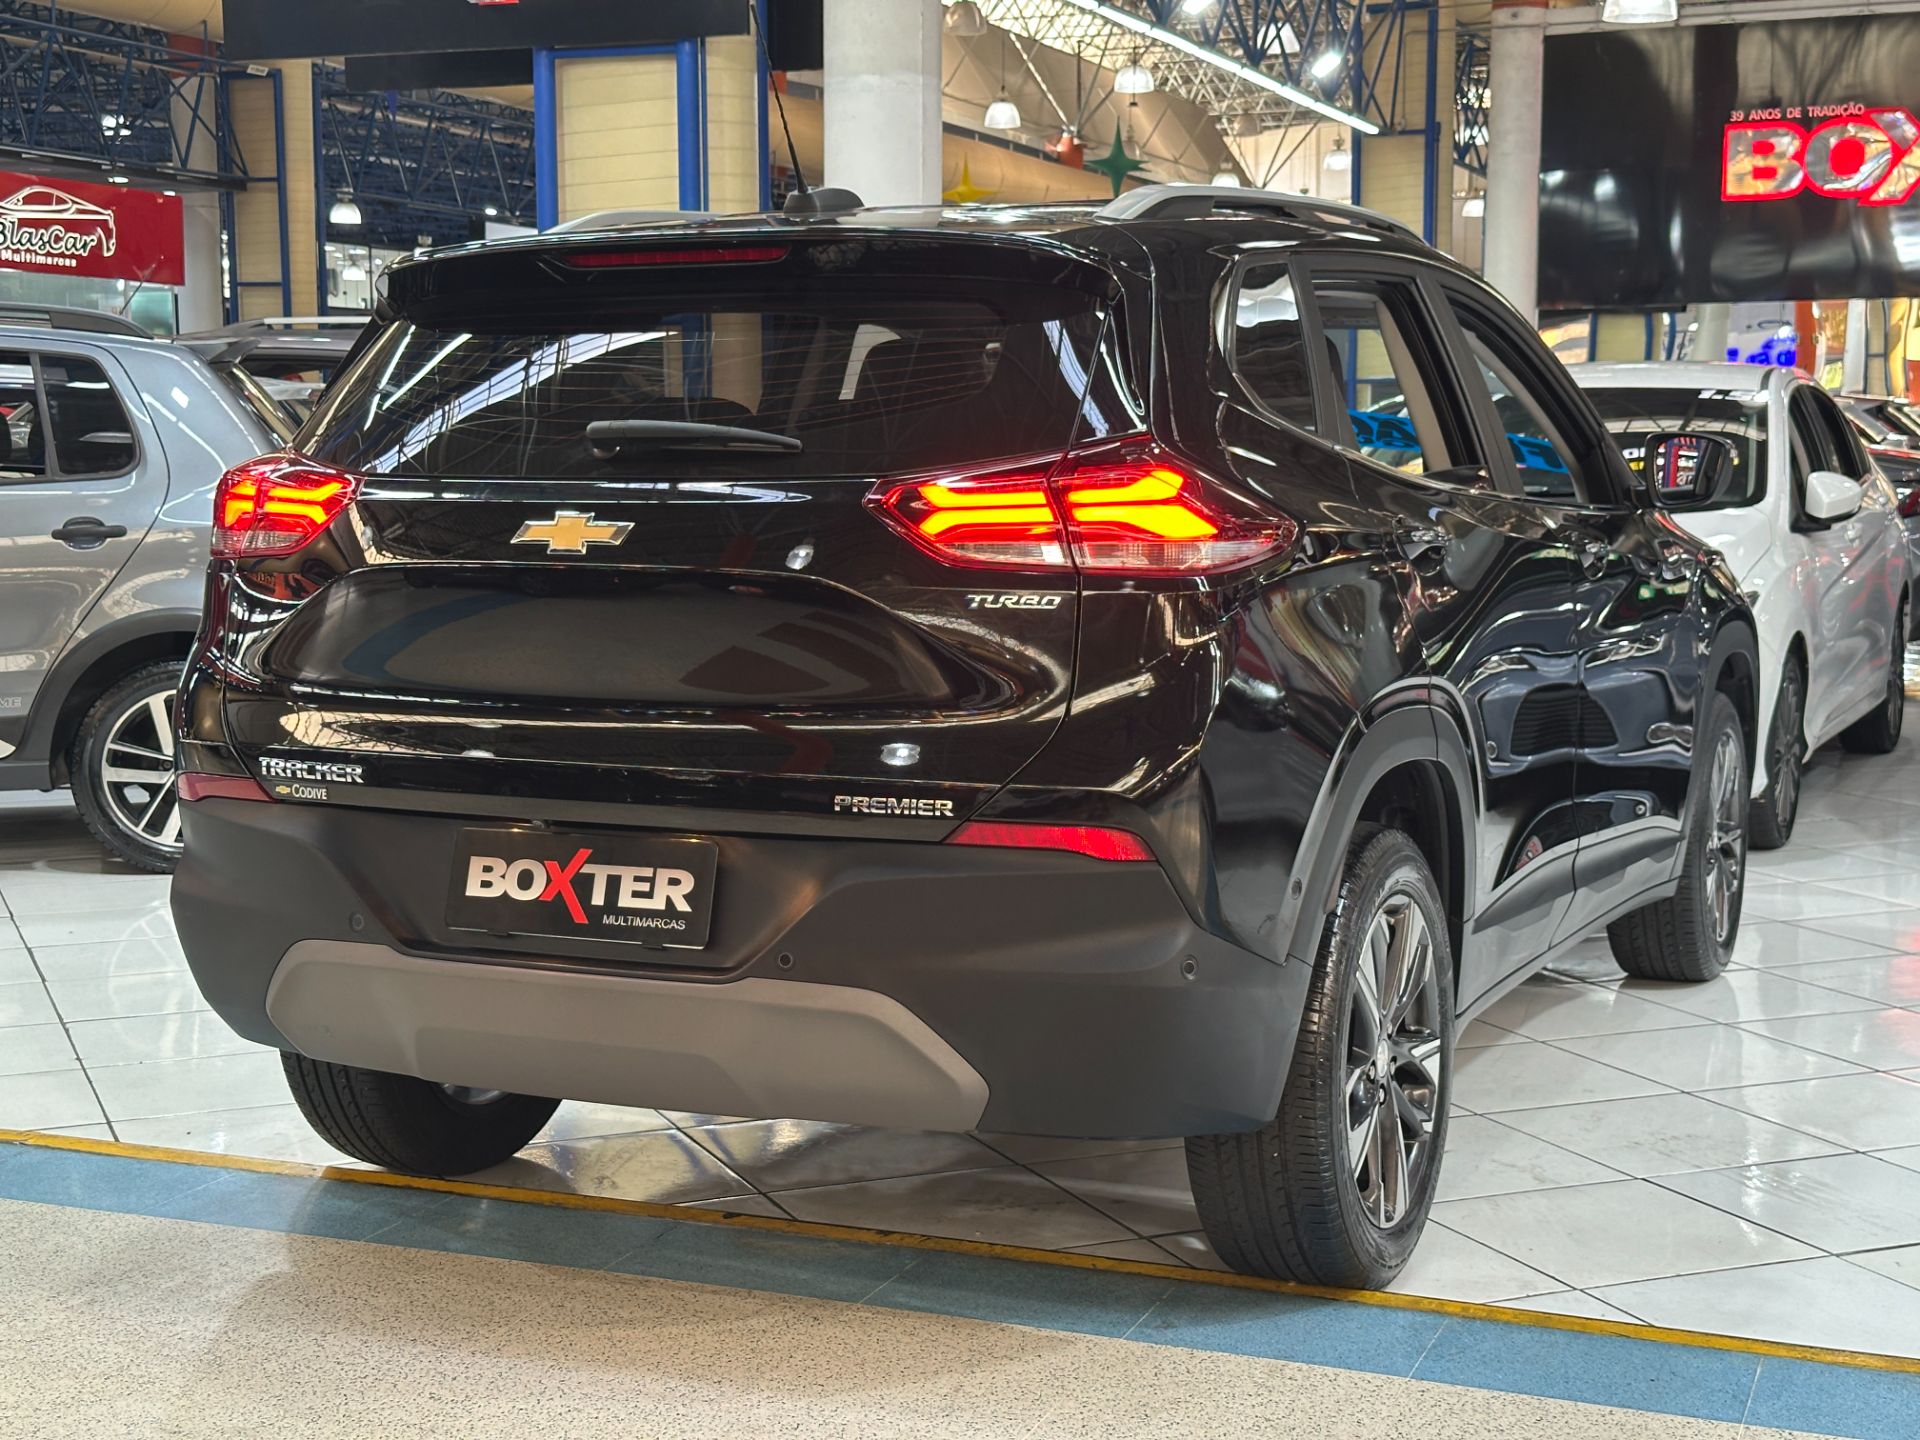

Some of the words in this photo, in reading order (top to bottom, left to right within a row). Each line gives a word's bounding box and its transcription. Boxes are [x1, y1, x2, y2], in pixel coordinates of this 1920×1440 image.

[1730, 110, 1744, 121] 39
[1749, 108, 1781, 120] ANOS
[1786, 107, 1802, 118] DE
[1807, 102, 1865, 118] TRADIÇÃO
[1, 249, 77, 267] Multimarcas
[964, 594, 1062, 610] TURBO
[258, 756, 364, 783] TRACKER
[834, 795, 954, 817] PREMIER
[465, 848, 695, 924] BOXTER
[602, 914, 686, 930] MULTIMARCAS
